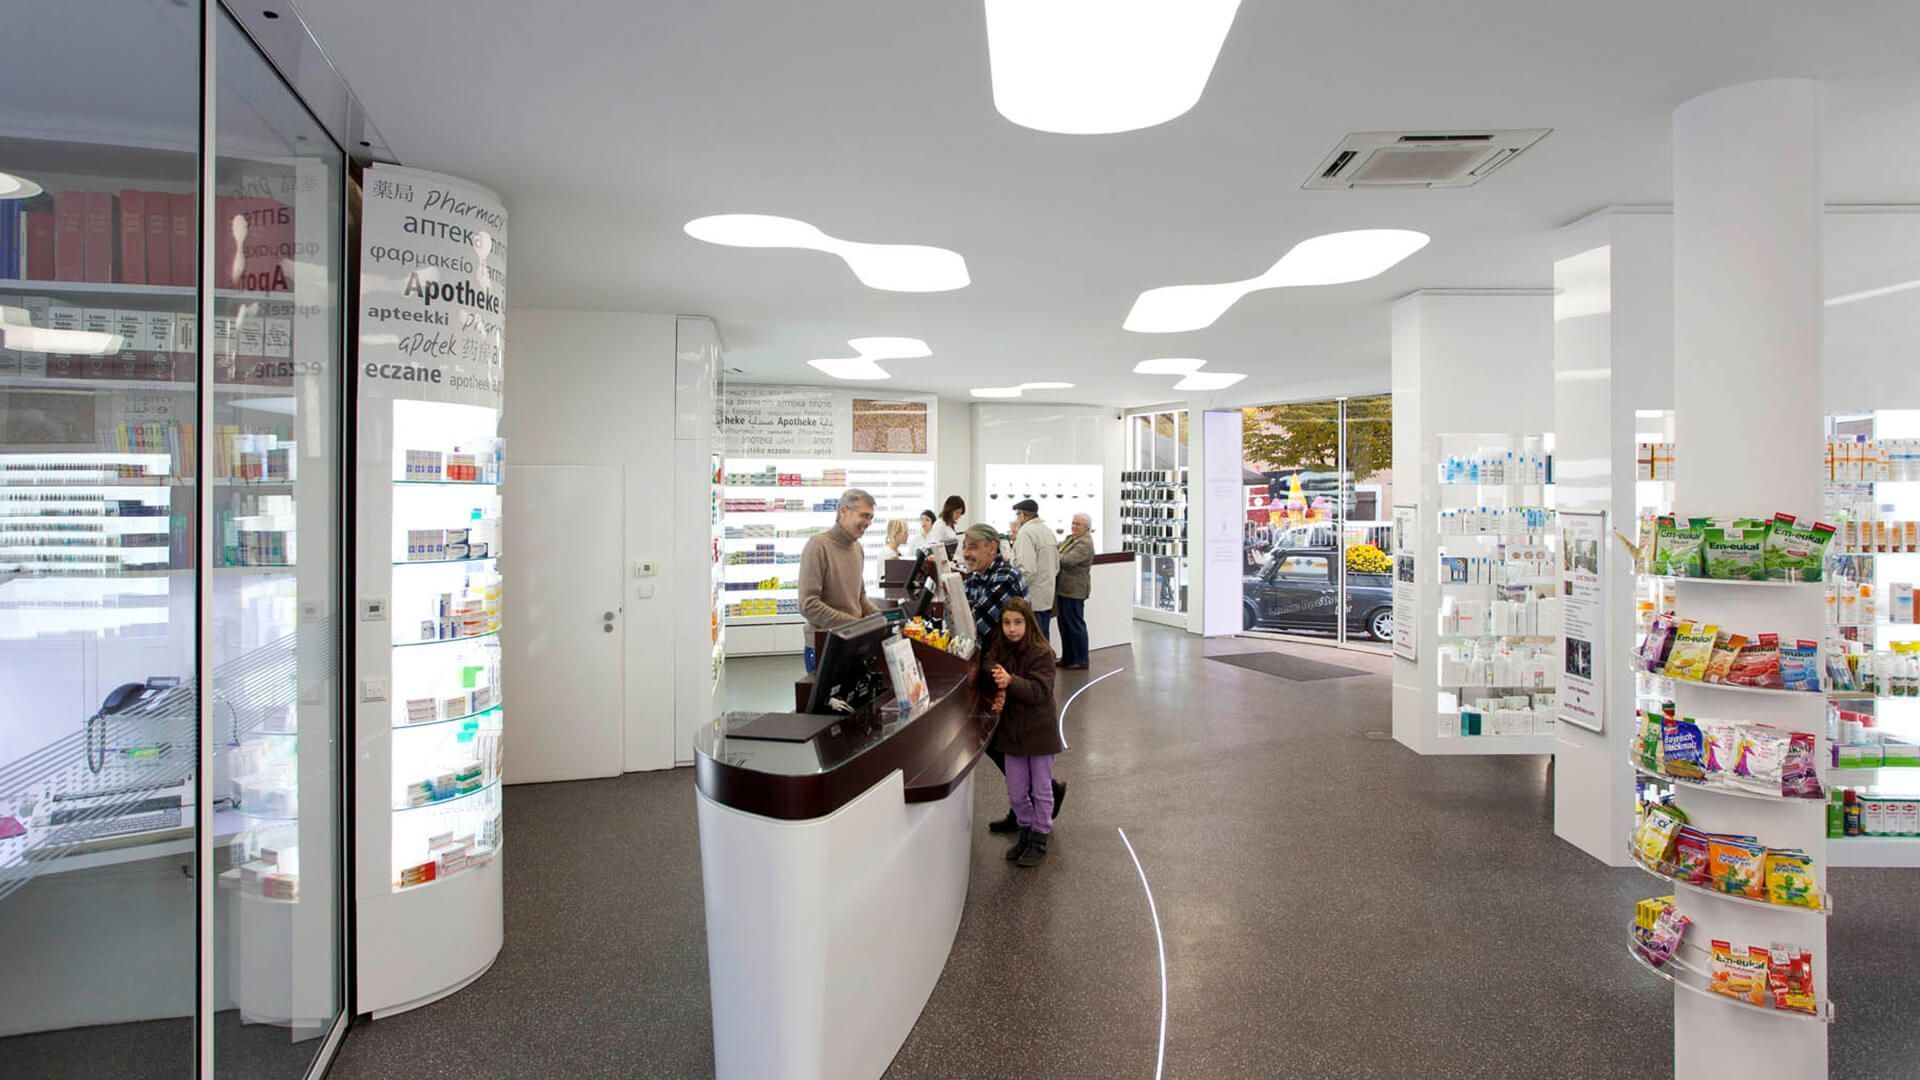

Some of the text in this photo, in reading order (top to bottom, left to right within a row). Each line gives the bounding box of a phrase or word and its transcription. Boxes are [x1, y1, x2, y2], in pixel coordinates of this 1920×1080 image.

[404, 271, 500, 315] Apotheke
[368, 306, 449, 326] apteekki
[365, 361, 442, 383] eczane
[777, 417, 817, 428] Apotheke
[1774, 525, 1826, 546] Em-eukal
[1709, 541, 1760, 551] Em-eukal
[1716, 953, 1765, 969] Em-eukal
